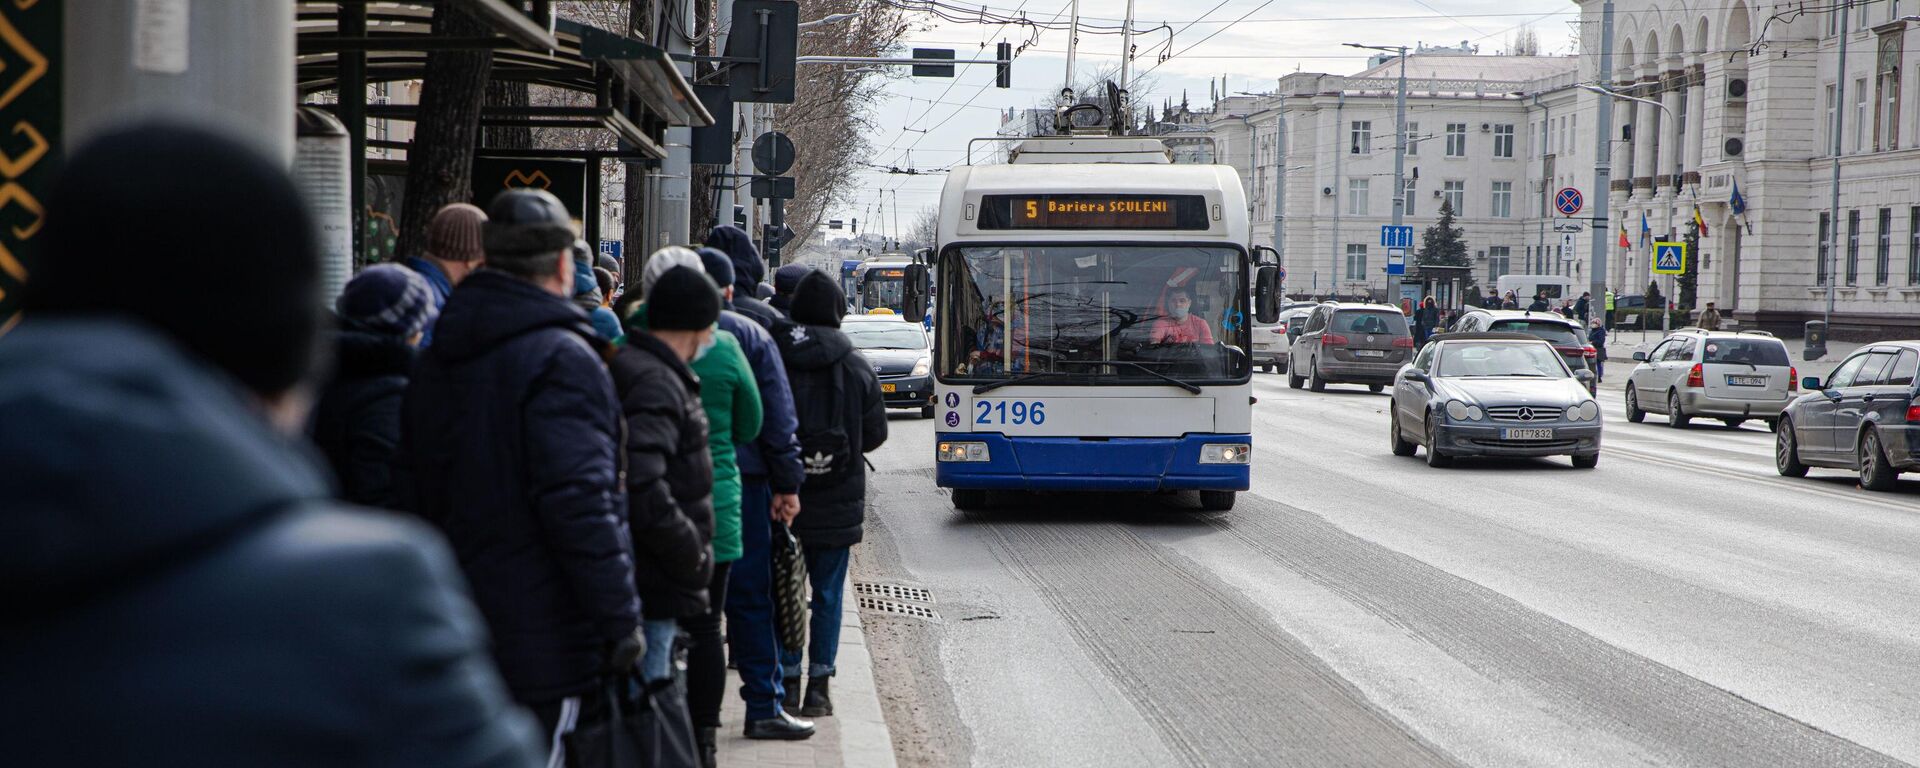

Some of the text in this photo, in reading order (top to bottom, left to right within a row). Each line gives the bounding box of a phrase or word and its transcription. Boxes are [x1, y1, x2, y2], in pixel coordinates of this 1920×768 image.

[1025, 200, 1168, 219] 5 Bariera SCULENI
[975, 400, 1046, 426] 2196
